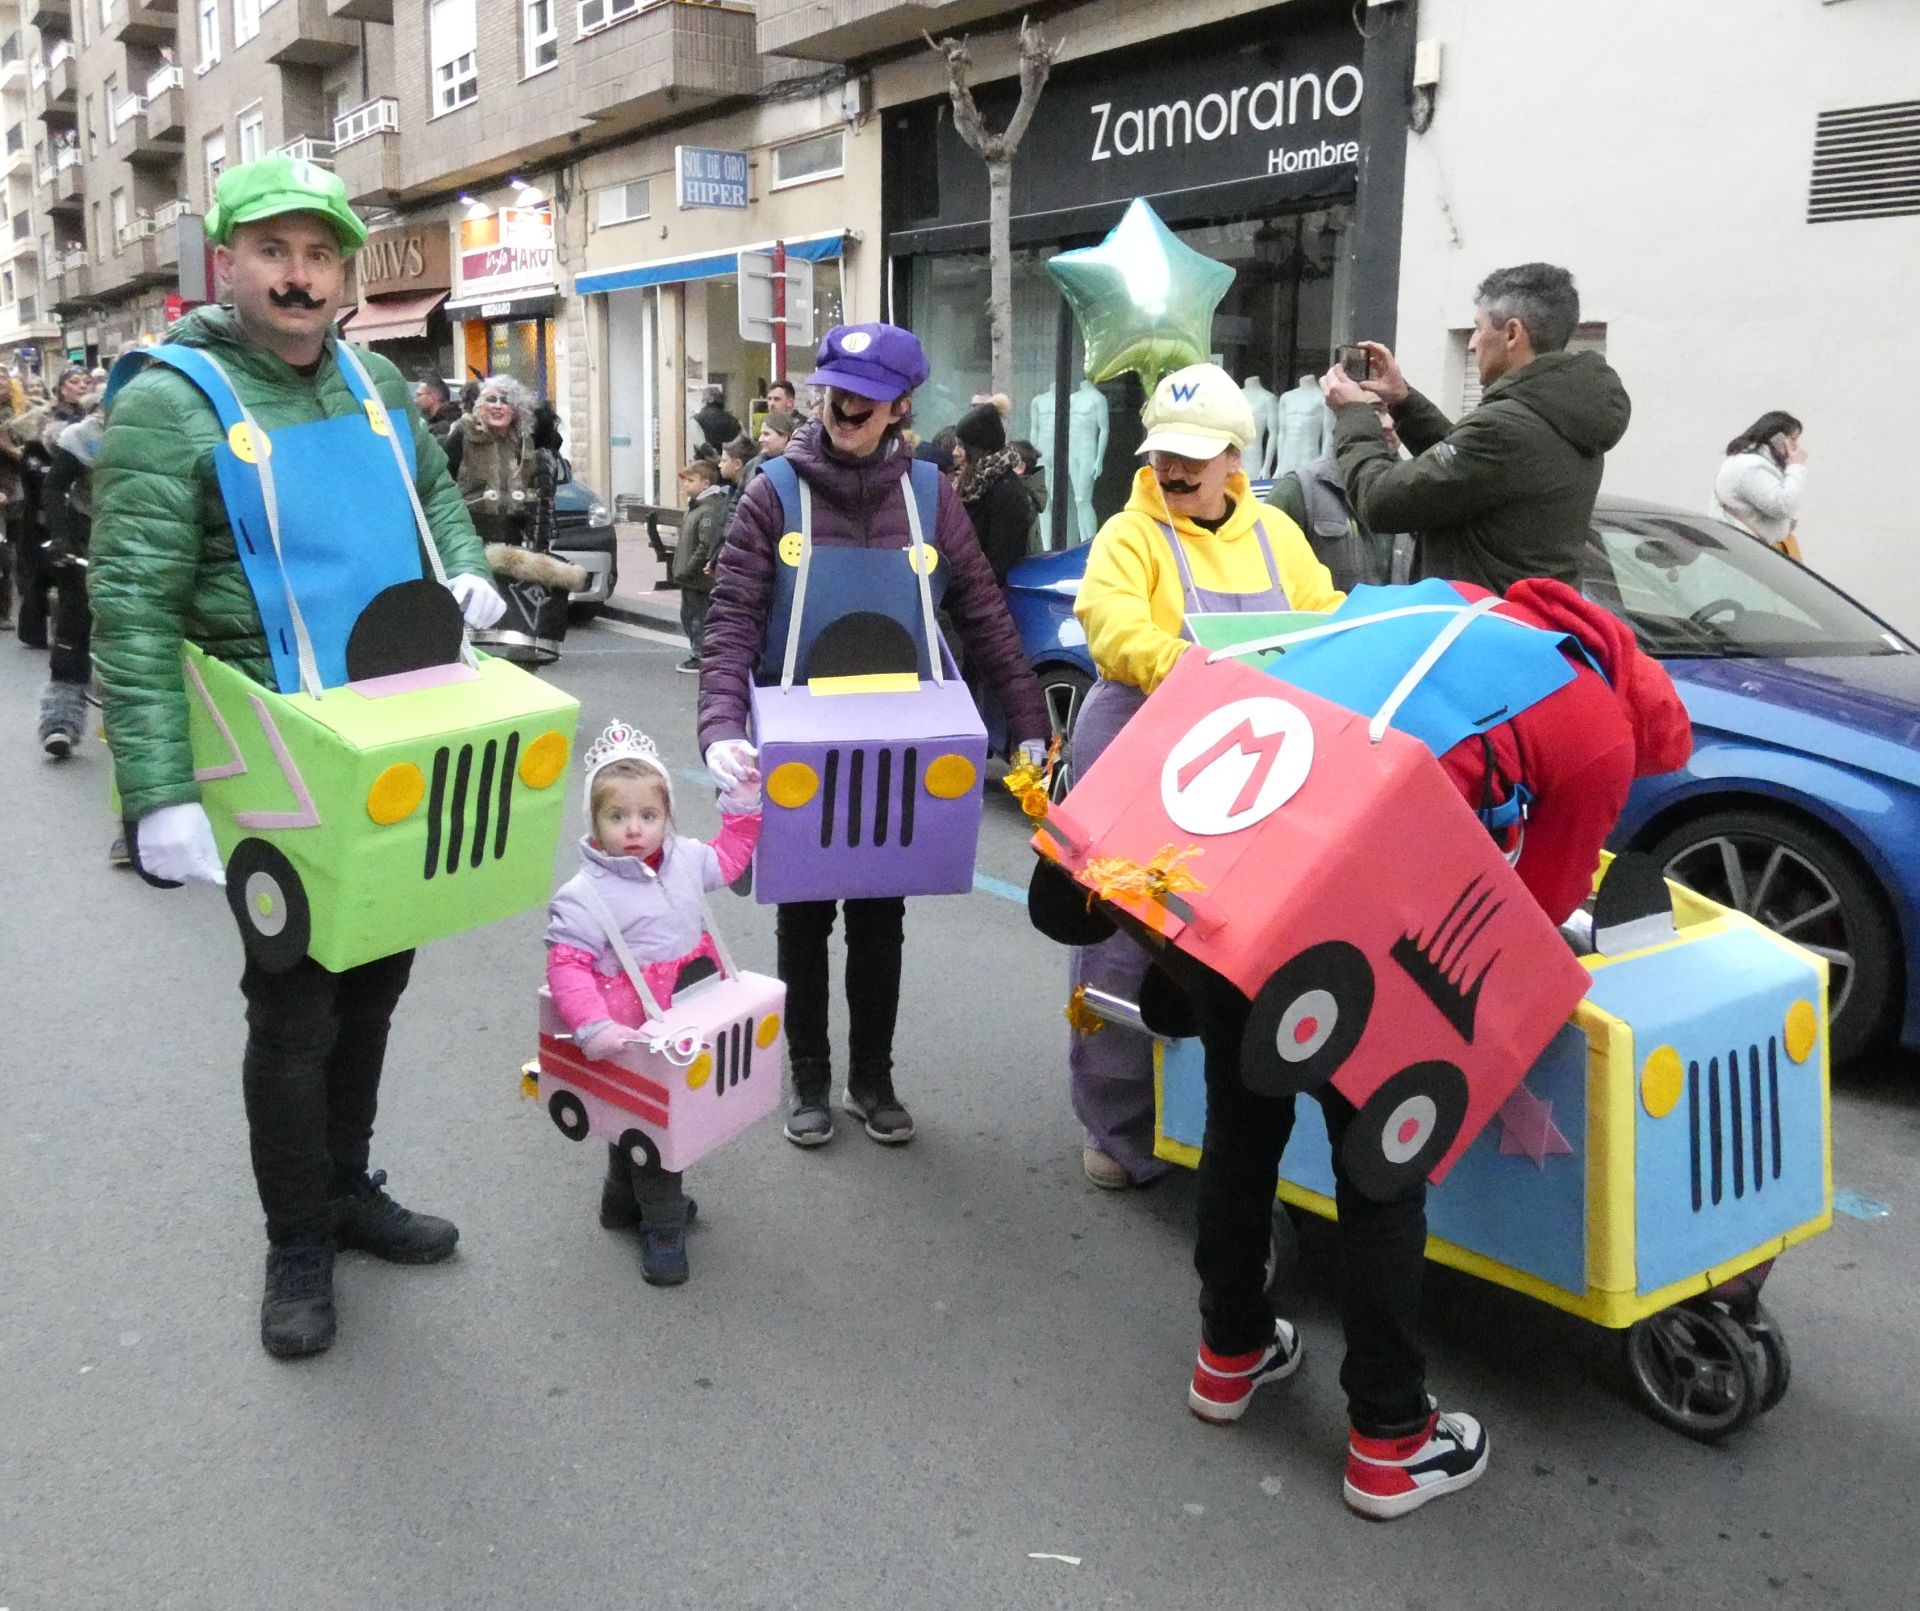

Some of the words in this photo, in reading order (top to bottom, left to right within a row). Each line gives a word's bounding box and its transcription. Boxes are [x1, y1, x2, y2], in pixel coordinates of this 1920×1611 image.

[1091, 65, 1364, 161] Zamorano
[683, 151, 703, 177] SOL
[706, 153, 721, 180] DE
[724, 155, 745, 182] ORO
[1267, 140, 1359, 173] Hombre
[684, 180, 746, 206] HIPER
[1171, 383, 1200, 402] W
[1178, 717, 1286, 818] M
